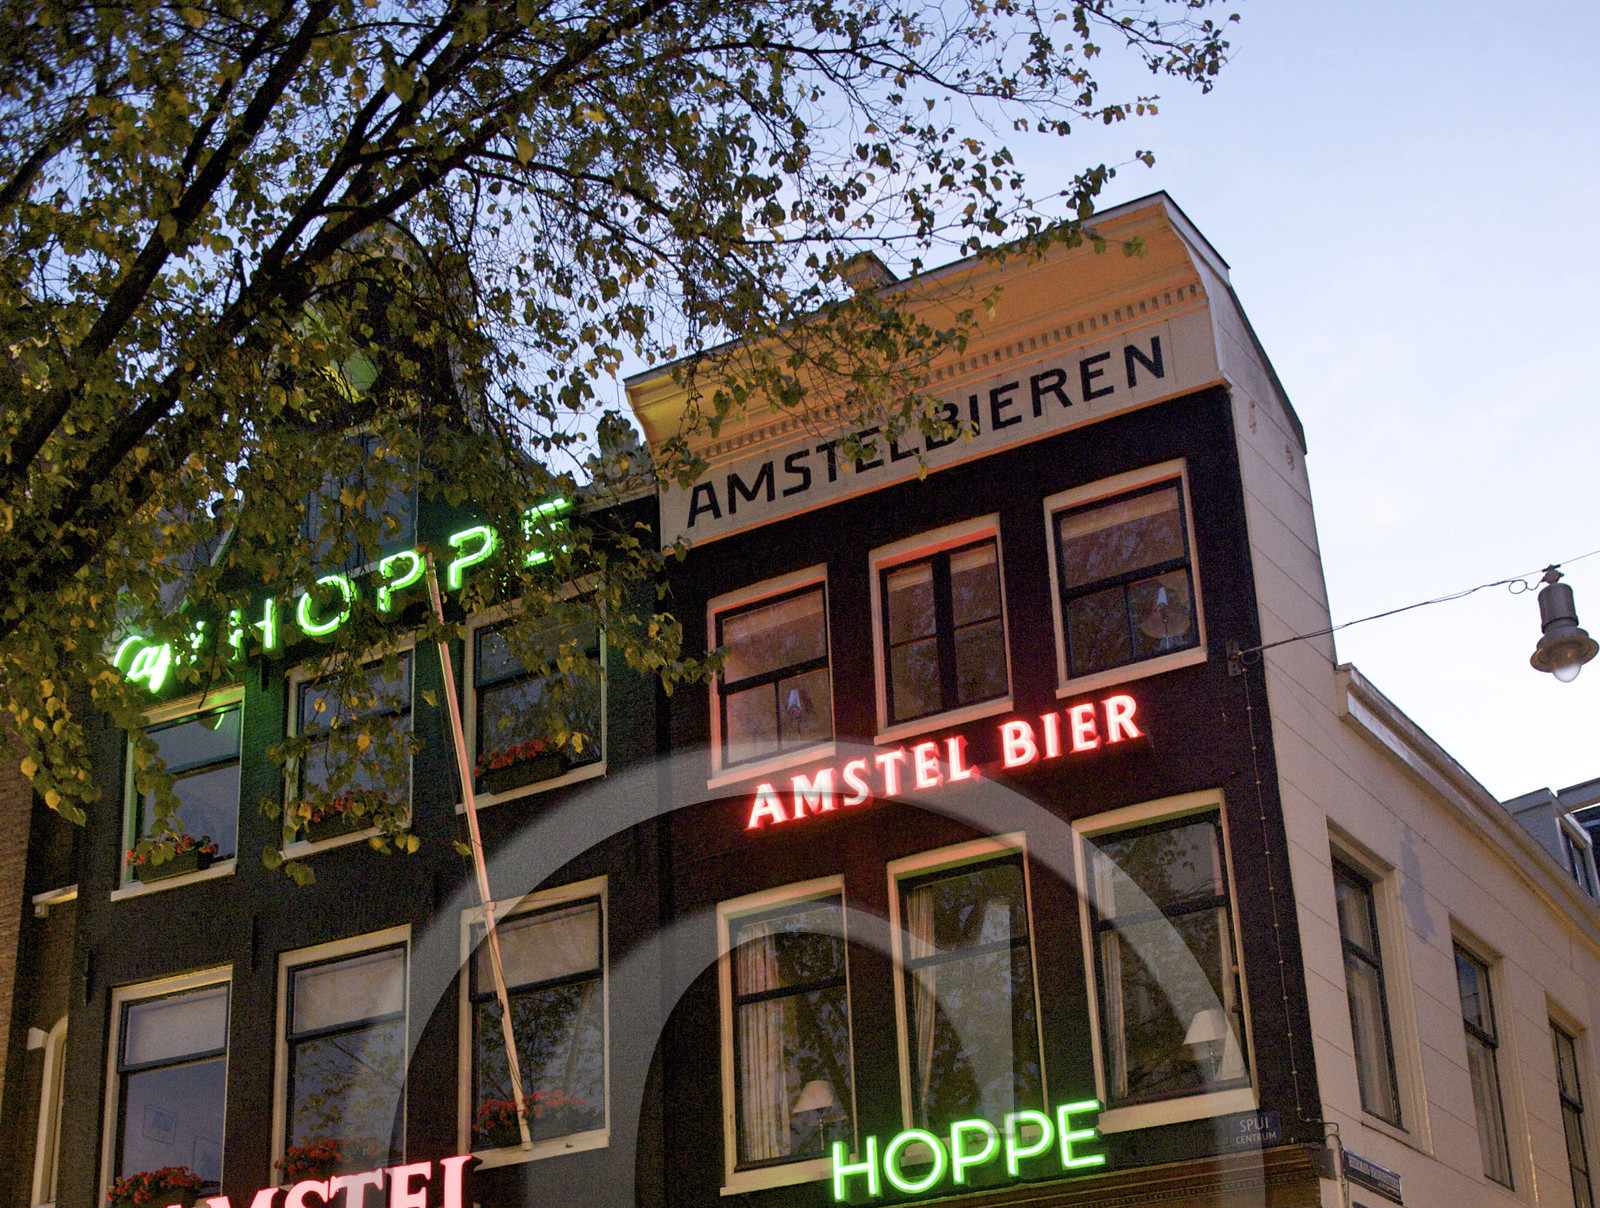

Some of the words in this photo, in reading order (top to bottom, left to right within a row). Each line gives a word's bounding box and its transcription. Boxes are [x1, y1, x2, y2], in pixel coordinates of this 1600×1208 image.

[687, 335, 1166, 529] AMSTELBIEREN
[231, 497, 572, 651] HOPPE
[746, 735, 979, 830] AMSTEL
[1001, 694, 1145, 770] BIER
[831, 1099, 1106, 1202] HOPPE
[1235, 1131, 1277, 1144] CENTRUM
[1239, 1116, 1269, 1133] SPUI
